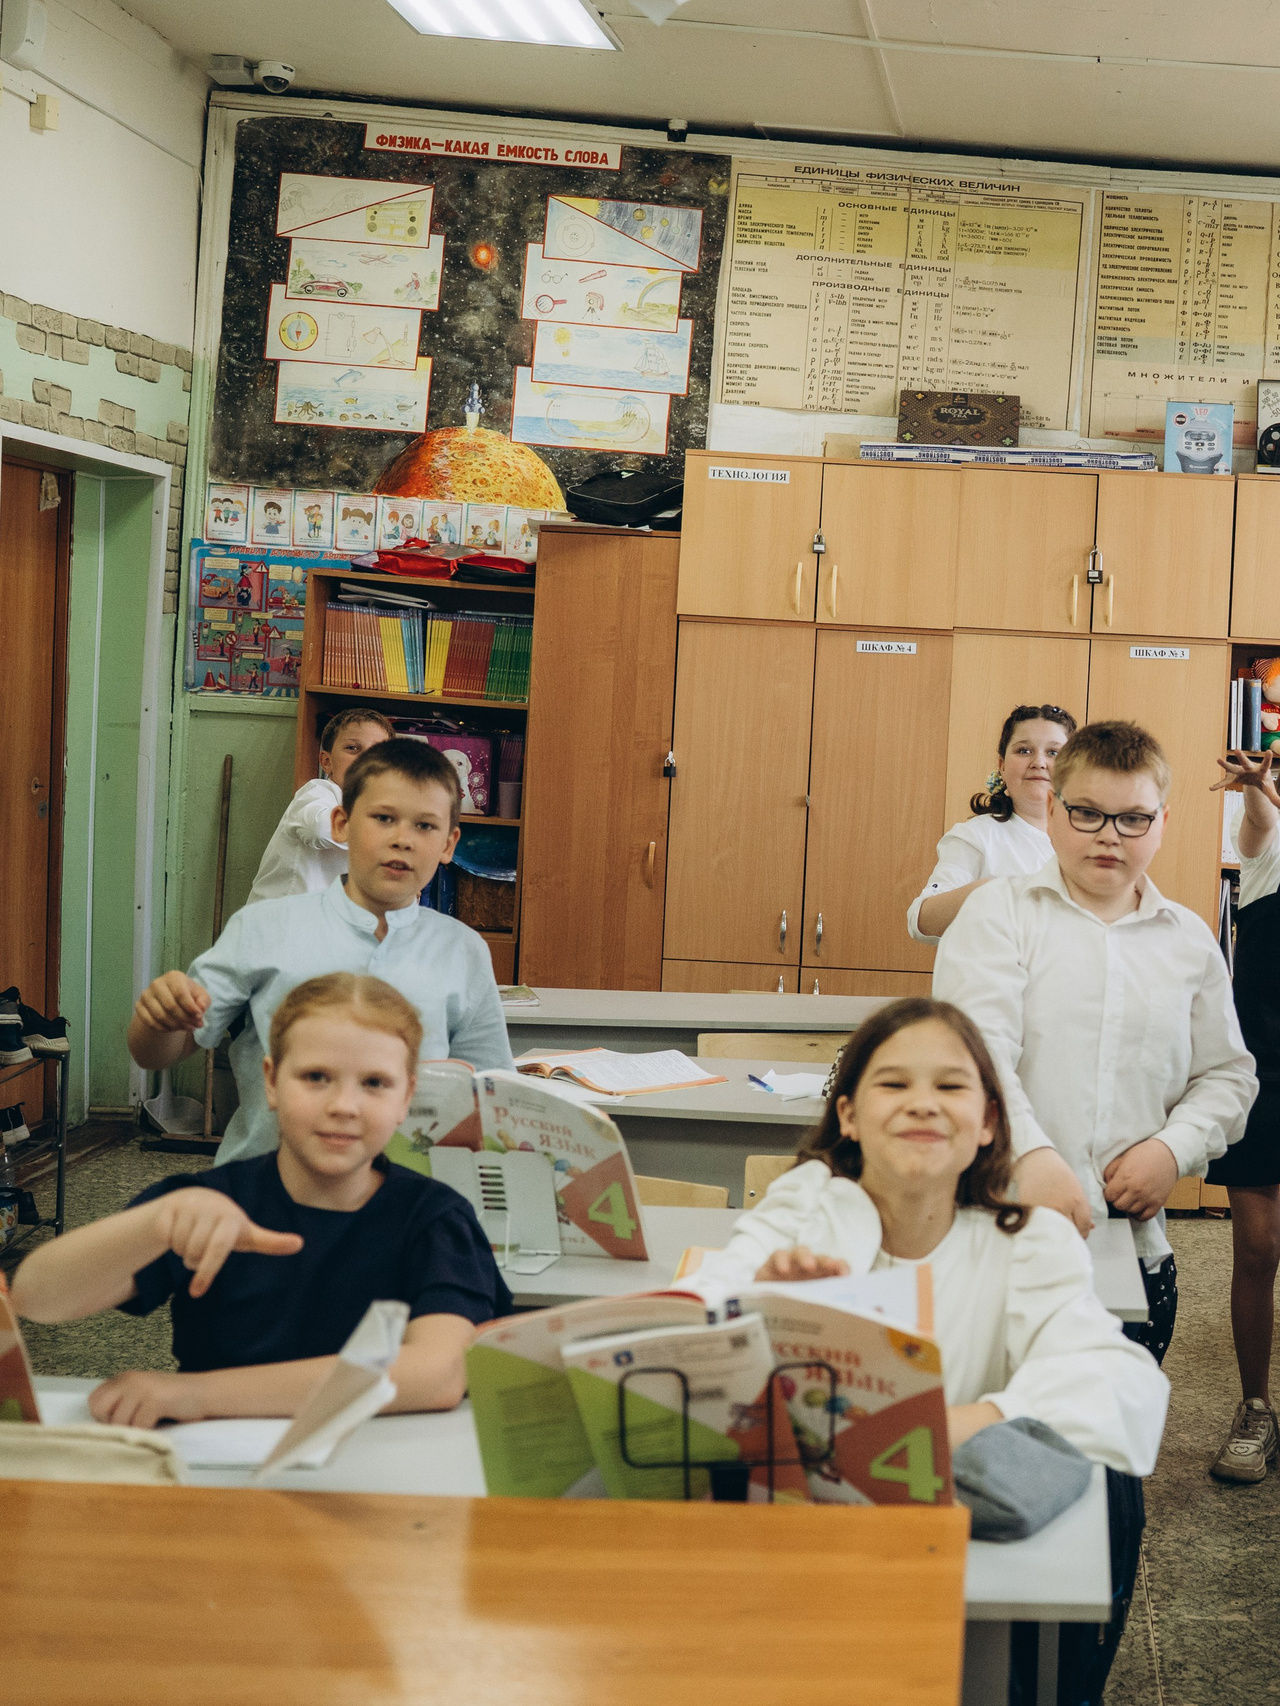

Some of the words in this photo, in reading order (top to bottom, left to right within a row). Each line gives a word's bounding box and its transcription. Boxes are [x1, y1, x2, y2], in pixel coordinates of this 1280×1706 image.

[498, 144, 559, 161] ЕМКОСТЬ
[565, 150, 609, 165] СЛОВА
[794, 166, 860, 178] ЕДИНИЦЫ
[866, 171, 954, 187] ФИЗИЧЕСКИХ
[959, 181, 1020, 192] ВЕЛИЧИН
[838, 201, 897, 212] ОСНОВНЫЕ
[904, 207, 956, 217] ЕДИНИЦЫ
[796, 254, 893, 268] ДОПОЛНИТЕЛЬНЫЕ
[899, 263, 951, 273] ЕДИНИЦЫ
[812, 281, 891, 292] ПРОИЗВОДНЫЕ
[897, 288, 950, 298] ЕДИНИЦЫ
[940, 407, 980, 416] ROYAL
[1195, 408, 1208, 416] LED
[711, 469, 787, 481] ТЕХНОЛОГИЯ
[862, 643, 893, 651] ШКАФ
[1135, 649, 1166, 657] ШКАФ
[1168, 650, 1178, 658] №
[493, 1106, 573, 1137] Русский
[587, 1181, 637, 1240] 4
[869, 1426, 945, 1503] 4
